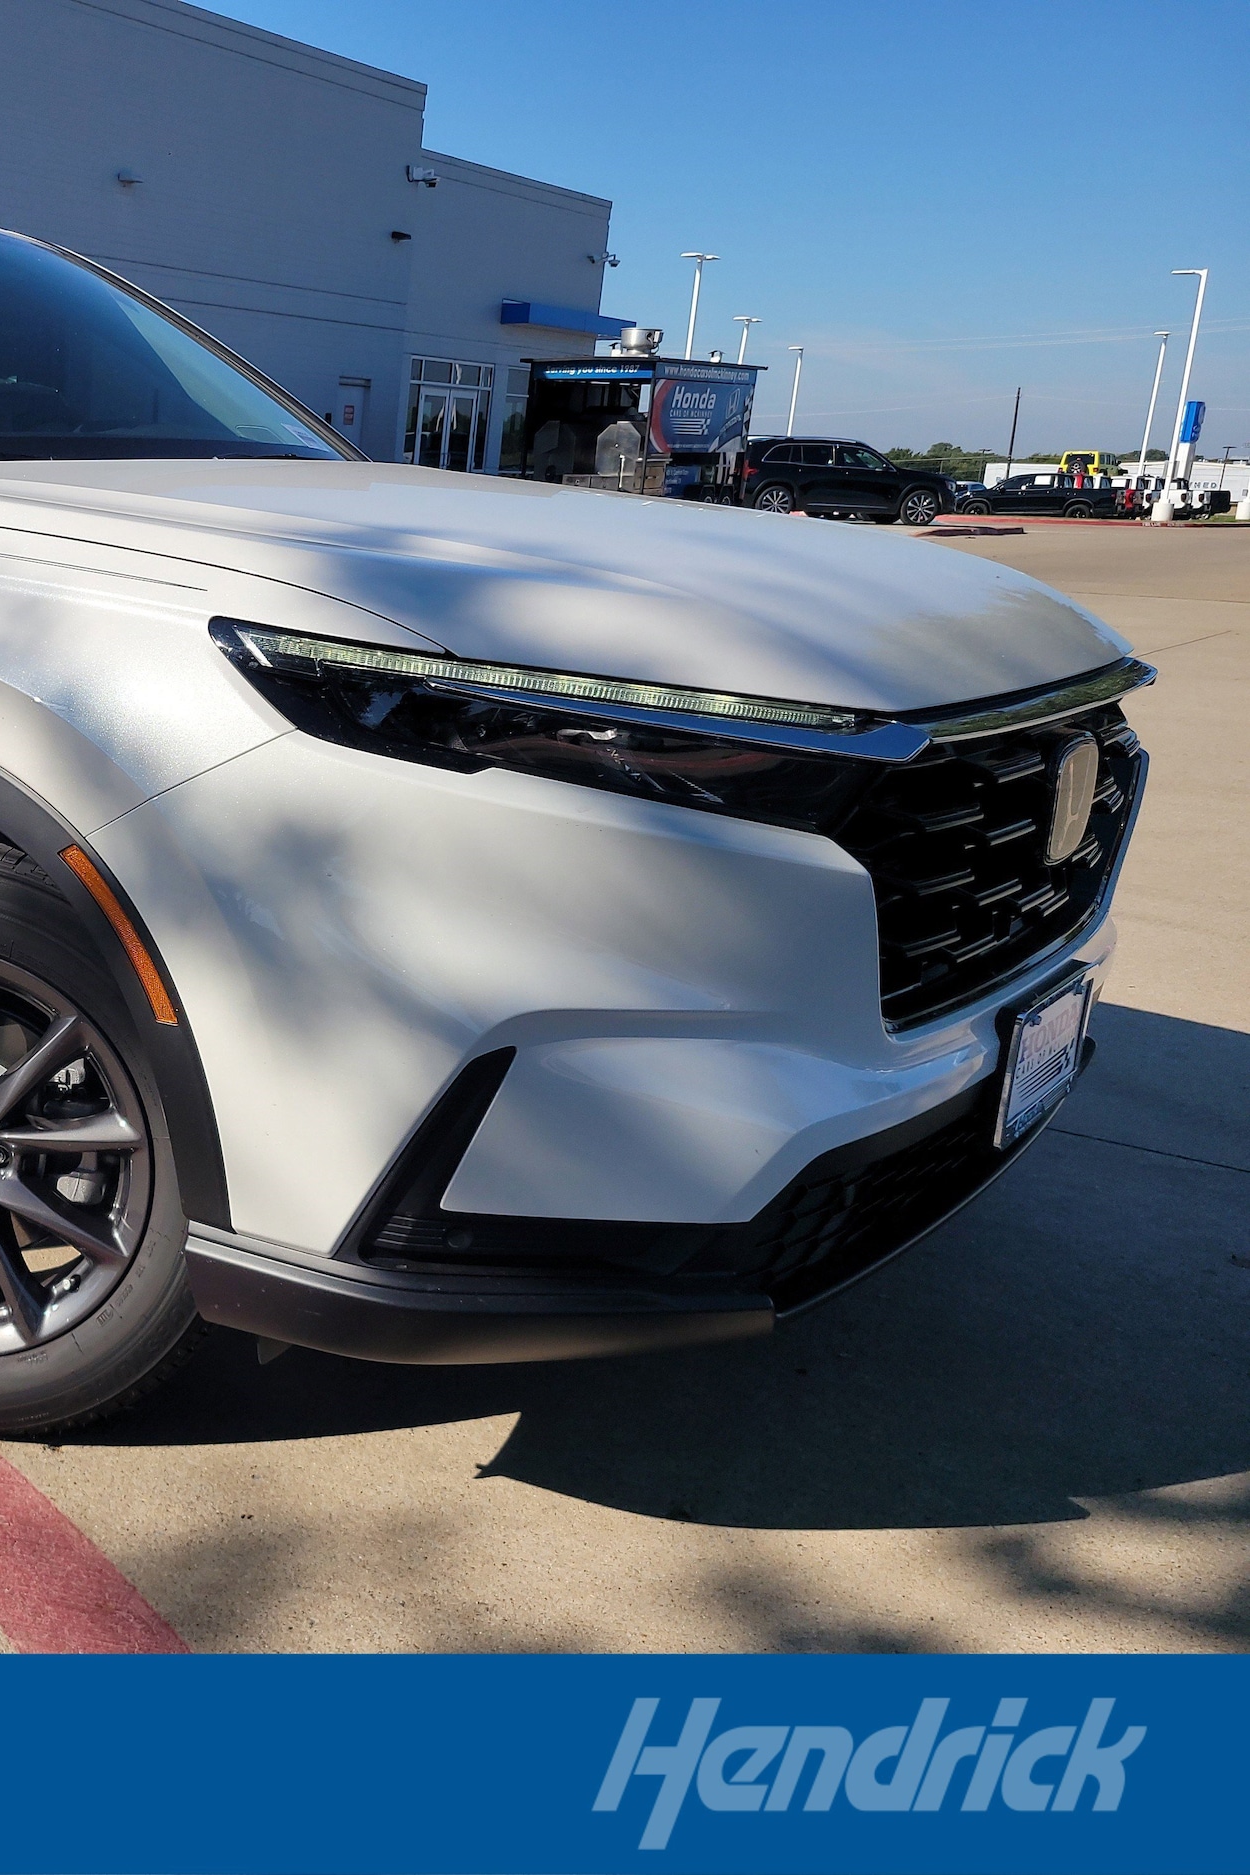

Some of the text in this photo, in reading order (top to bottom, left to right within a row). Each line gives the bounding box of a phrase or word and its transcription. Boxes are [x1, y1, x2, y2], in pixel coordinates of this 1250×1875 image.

[577, 366, 594, 375] you
[595, 364, 618, 373] since
[619, 364, 640, 373] 1987
[671, 385, 717, 410] Honda
[669, 409, 682, 418] CARS
[1018, 1001, 1080, 1065] HONDA
